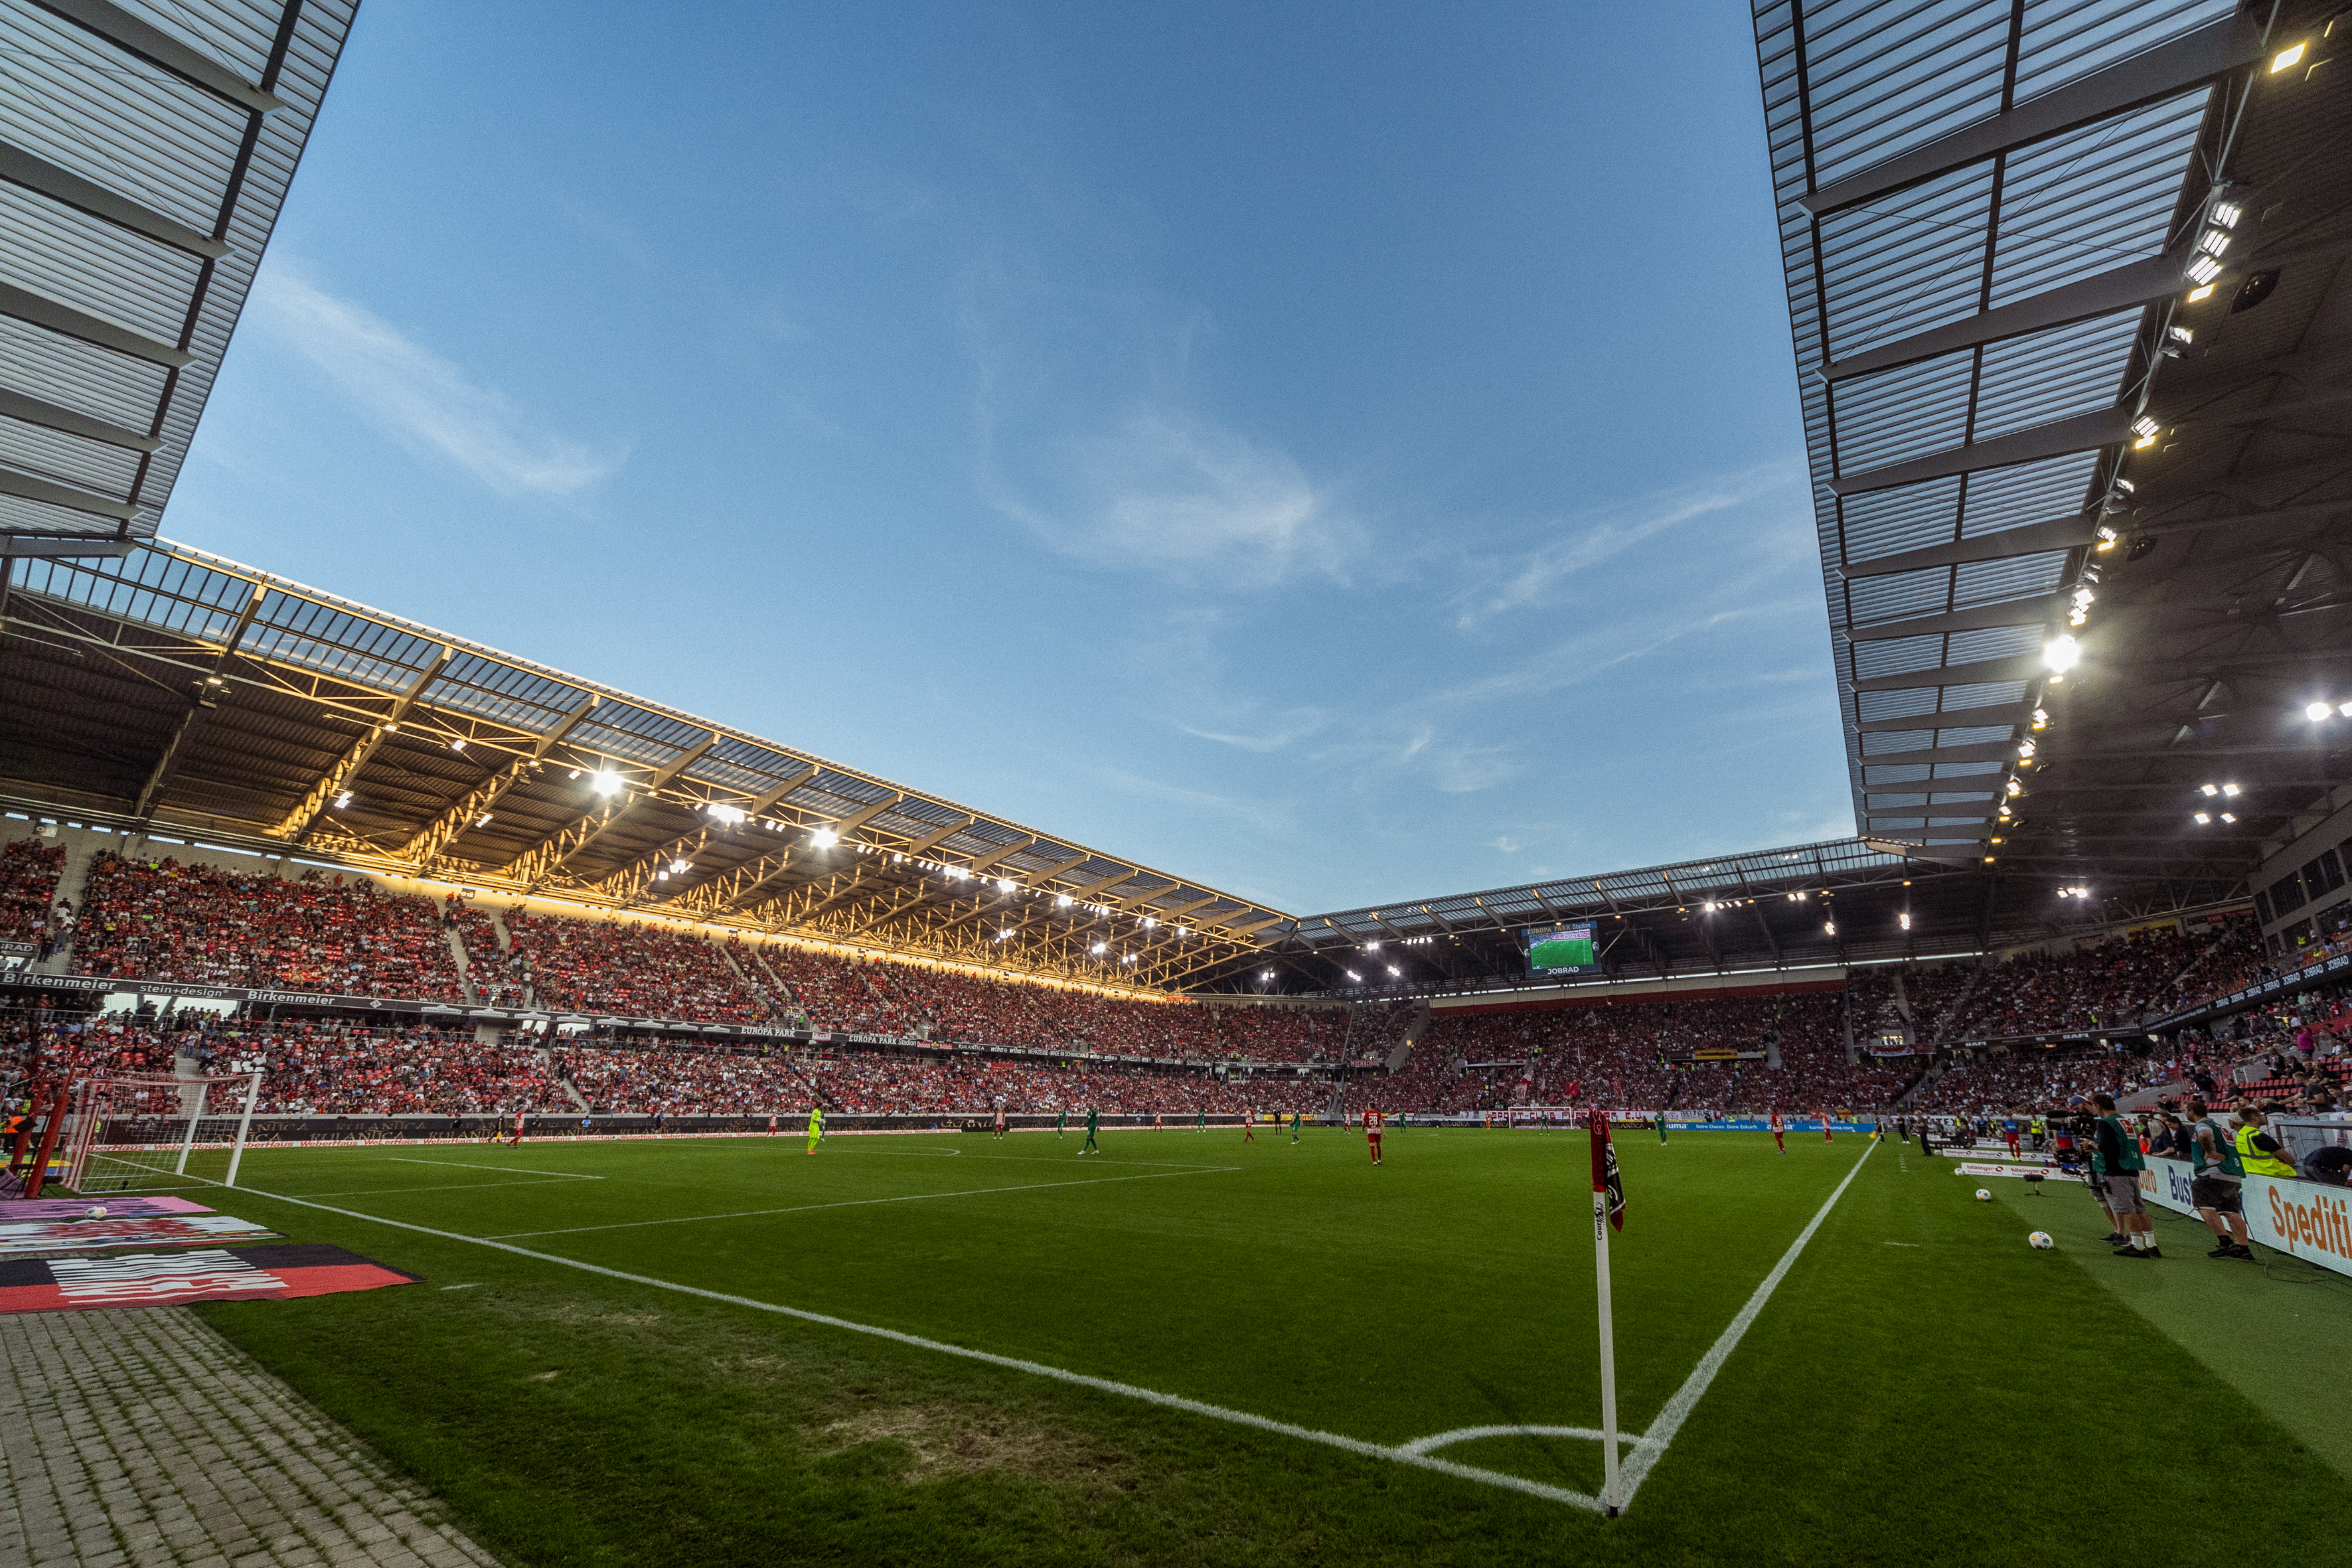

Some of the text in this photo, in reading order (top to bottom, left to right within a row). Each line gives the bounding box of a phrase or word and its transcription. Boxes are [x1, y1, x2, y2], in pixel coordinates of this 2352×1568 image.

[1528, 927, 1552, 935] EUROPA
[1554, 924, 1571, 933] PARK
[1, 943, 33, 952] RAD
[2327, 955, 2349, 971] JOBRAD
[1547, 966, 1579, 975] JOBRAD
[2304, 964, 2323, 979] JOBRAD
[3, 972, 117, 990] Birkenmeier
[2282, 972, 2301, 985] JOBRAD
[247, 990, 335, 1006] Birkenmeier
[741, 1026, 773, 1036] EUROPA
[848, 1035, 917, 1047] EUROPA PARK Stadion
[1369, 1116, 1378, 1125] 28
[310, 1129, 404, 1141] RULANTICA
